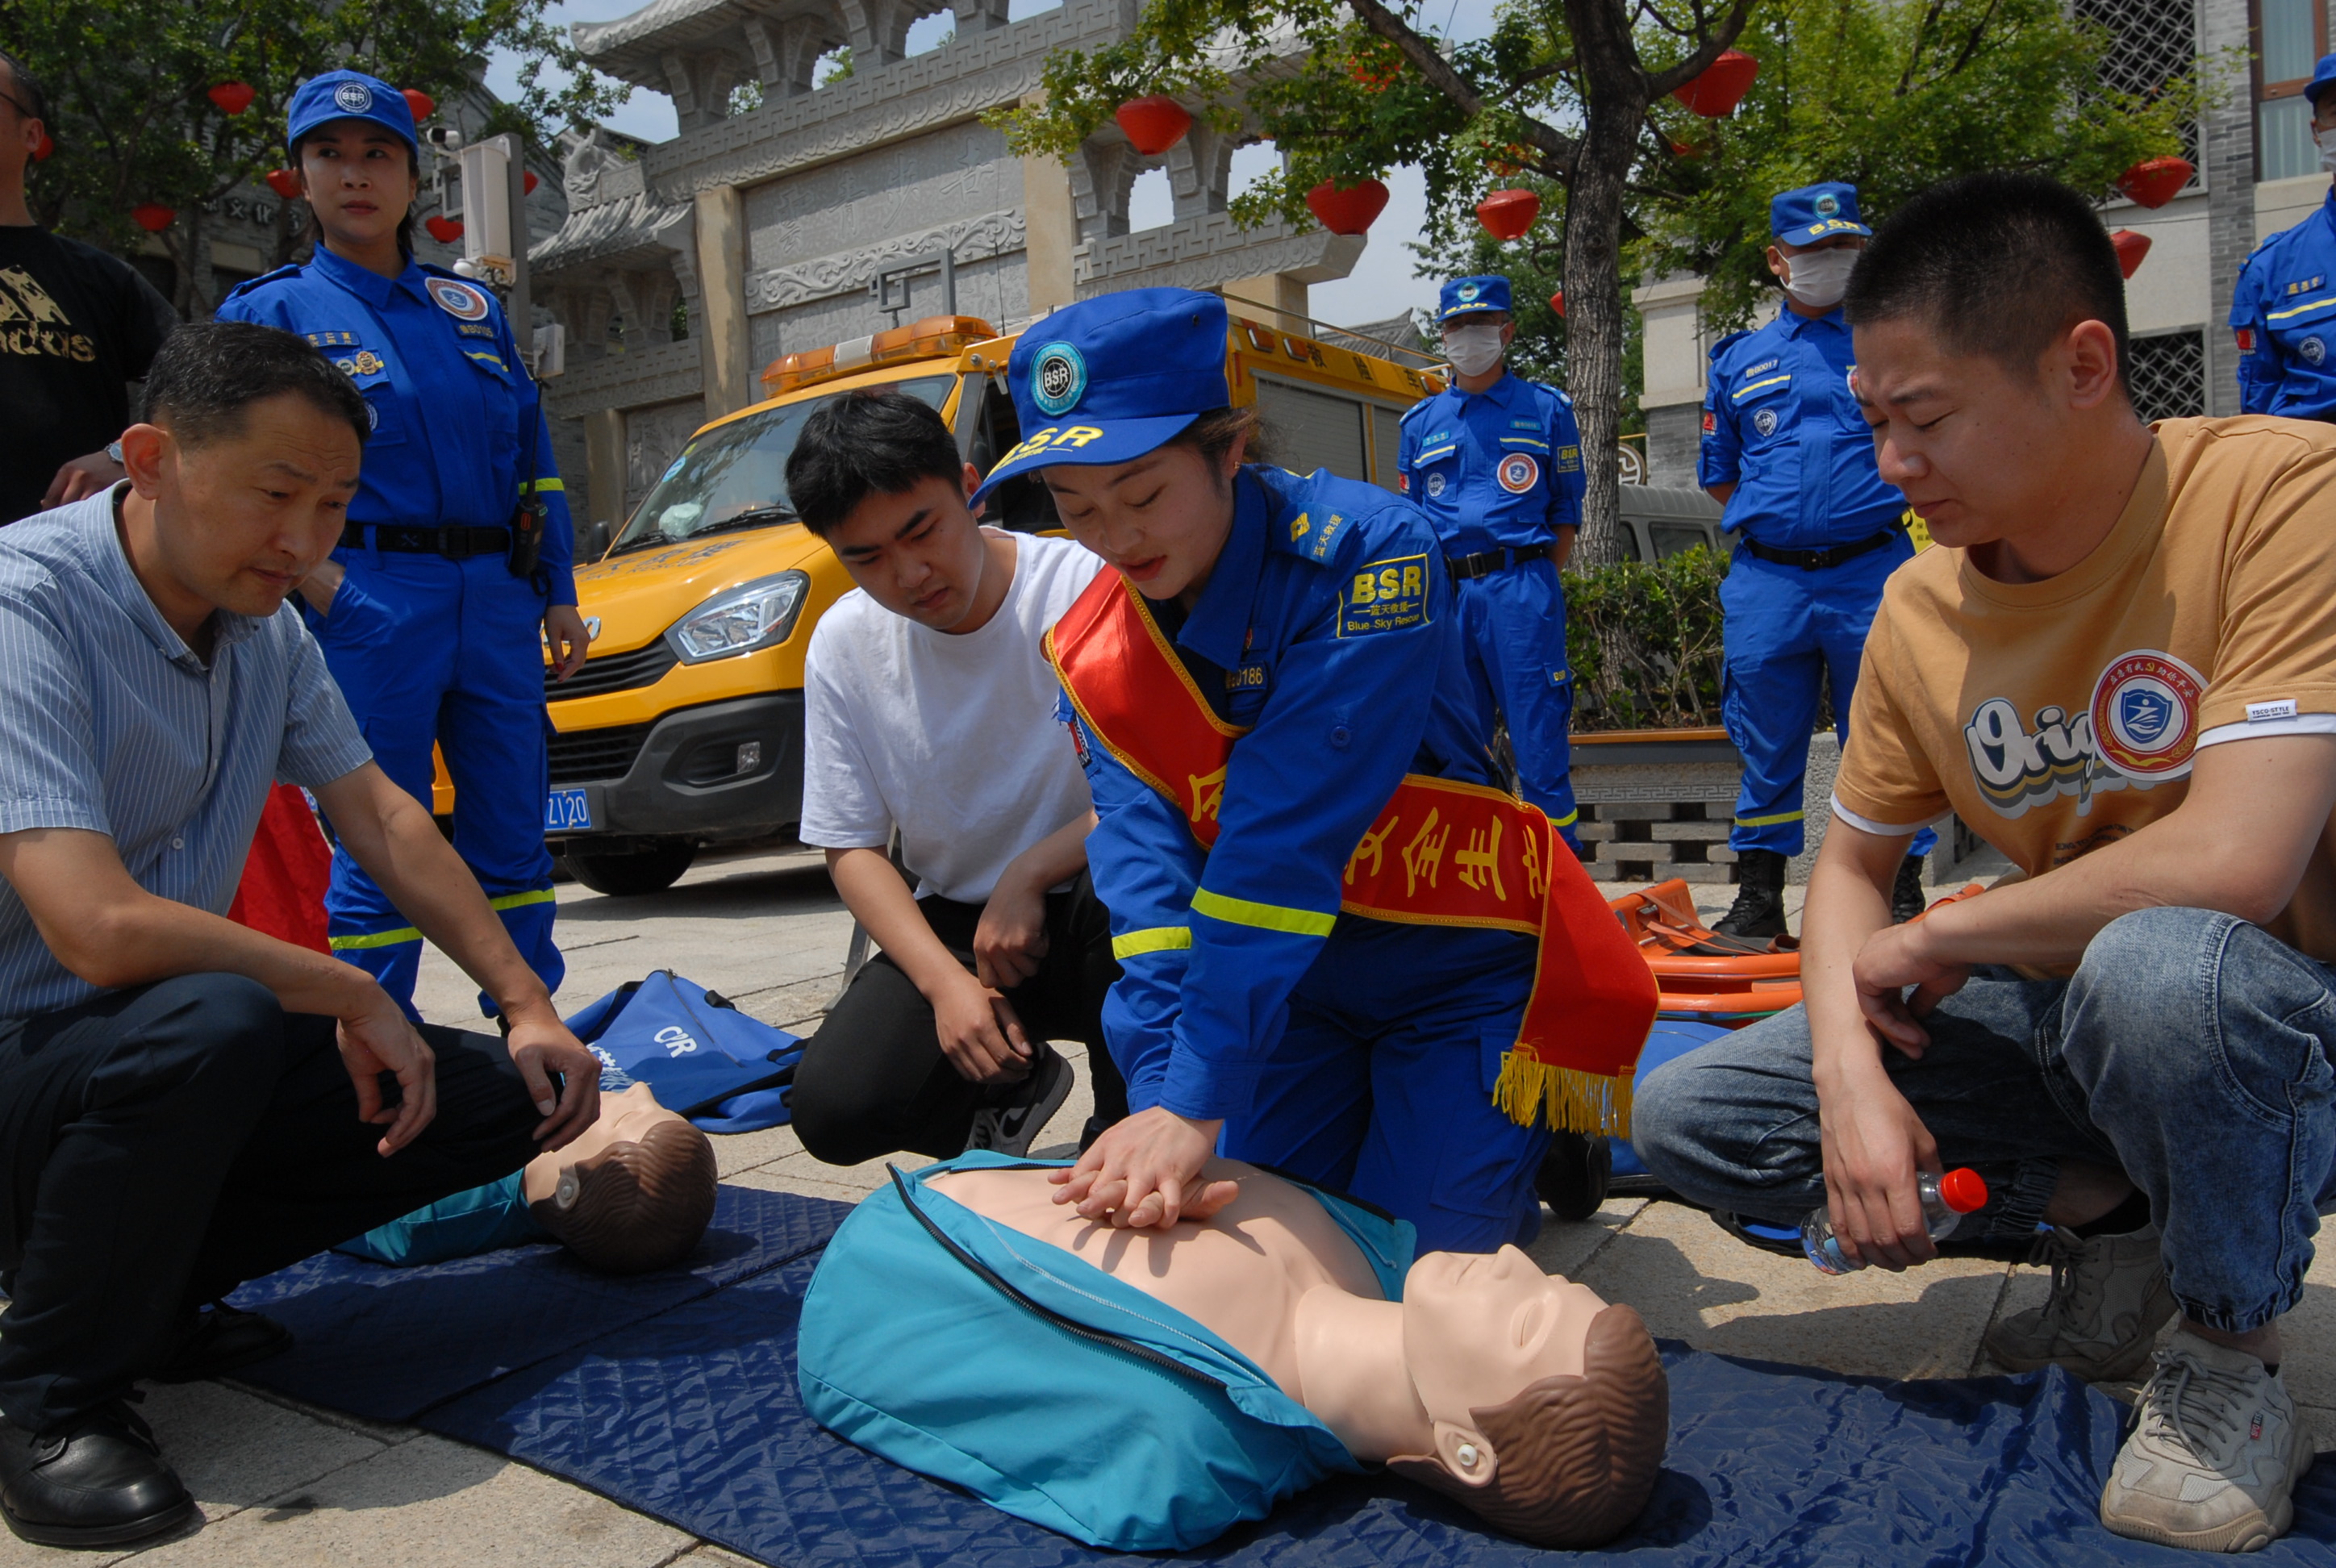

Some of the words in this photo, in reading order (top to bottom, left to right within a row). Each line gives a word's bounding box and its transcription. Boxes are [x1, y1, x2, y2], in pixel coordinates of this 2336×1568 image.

[342, 92, 365, 102] BSR
[1045, 368, 1069, 388] BSR
[1312, 513, 1344, 557] 蓝天救援
[1351, 565, 1421, 604] BSR
[1370, 600, 1409, 616] 蓝天救援
[1347, 620, 1370, 631] Blue
[1374, 617, 1393, 630] Sky
[653, 1025, 698, 1059] CPR
